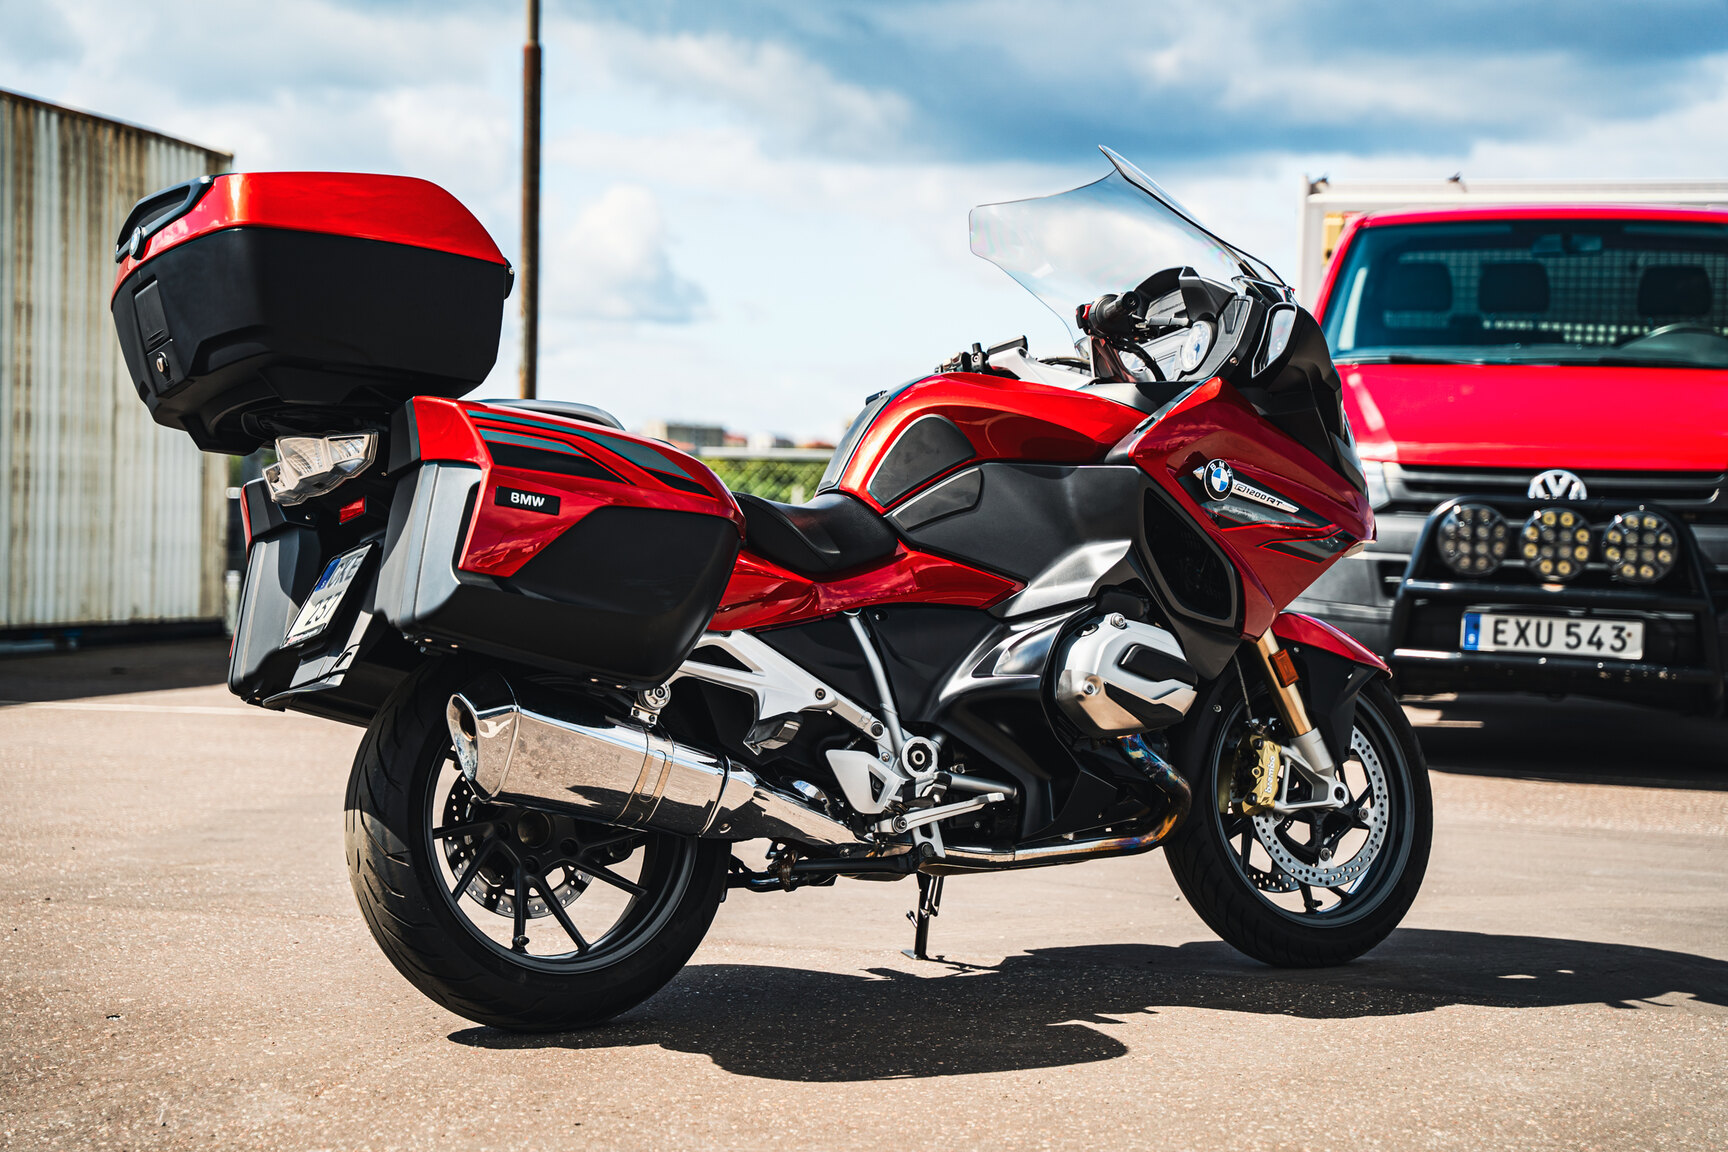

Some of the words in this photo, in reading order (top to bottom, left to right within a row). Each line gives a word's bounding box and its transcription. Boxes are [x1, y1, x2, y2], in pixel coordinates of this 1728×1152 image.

[511, 492, 545, 507] BMW
[1493, 619, 1553, 648] EXU
[1565, 622, 1627, 652] 543
[1264, 755, 1275, 794] brembo
